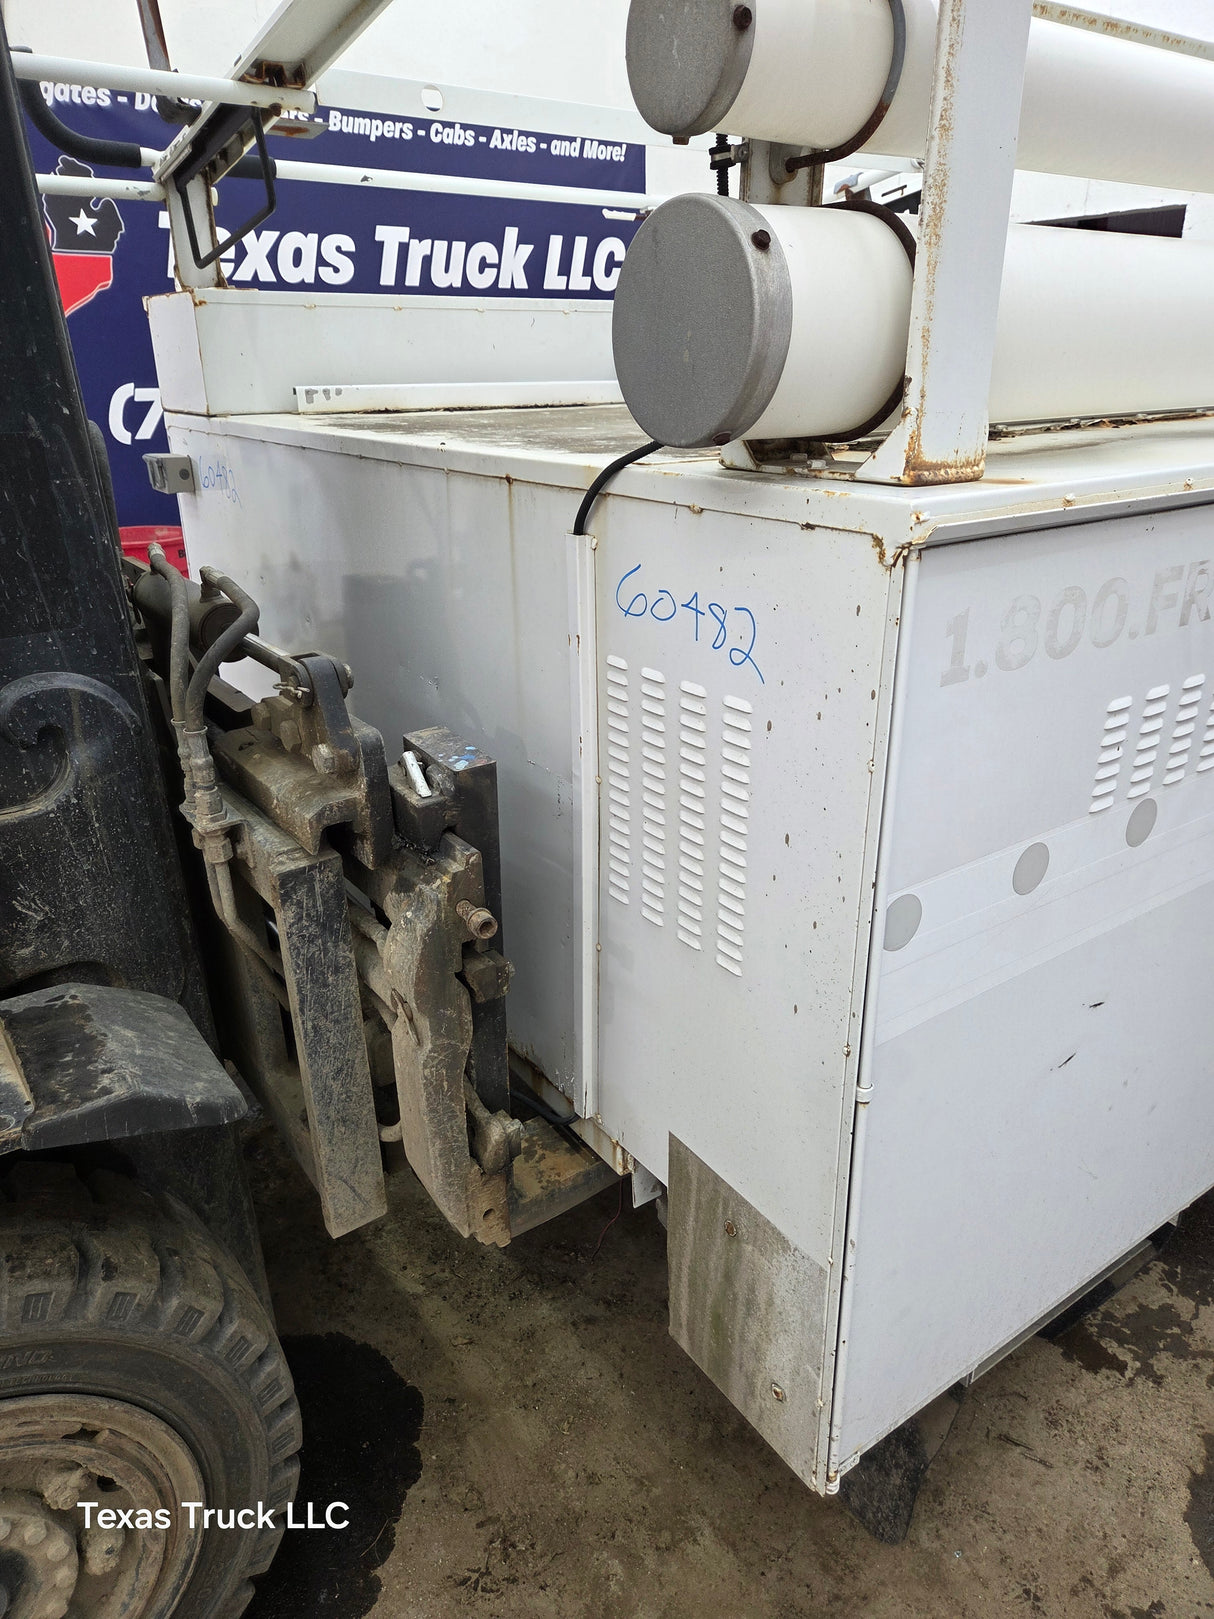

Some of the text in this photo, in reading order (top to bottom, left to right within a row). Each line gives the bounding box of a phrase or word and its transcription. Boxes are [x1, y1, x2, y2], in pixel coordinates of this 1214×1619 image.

[328, 110, 413, 141] Bumpers
[430, 122, 475, 147] Cabs
[489, 129, 536, 153] Axles
[550, 137, 580, 158] and
[583, 139, 627, 162] More!
[375, 225, 534, 289] Truck
[543, 235, 627, 291] LLC
[199, 455, 243, 509] 60482
[616, 564, 765, 684] 60482
